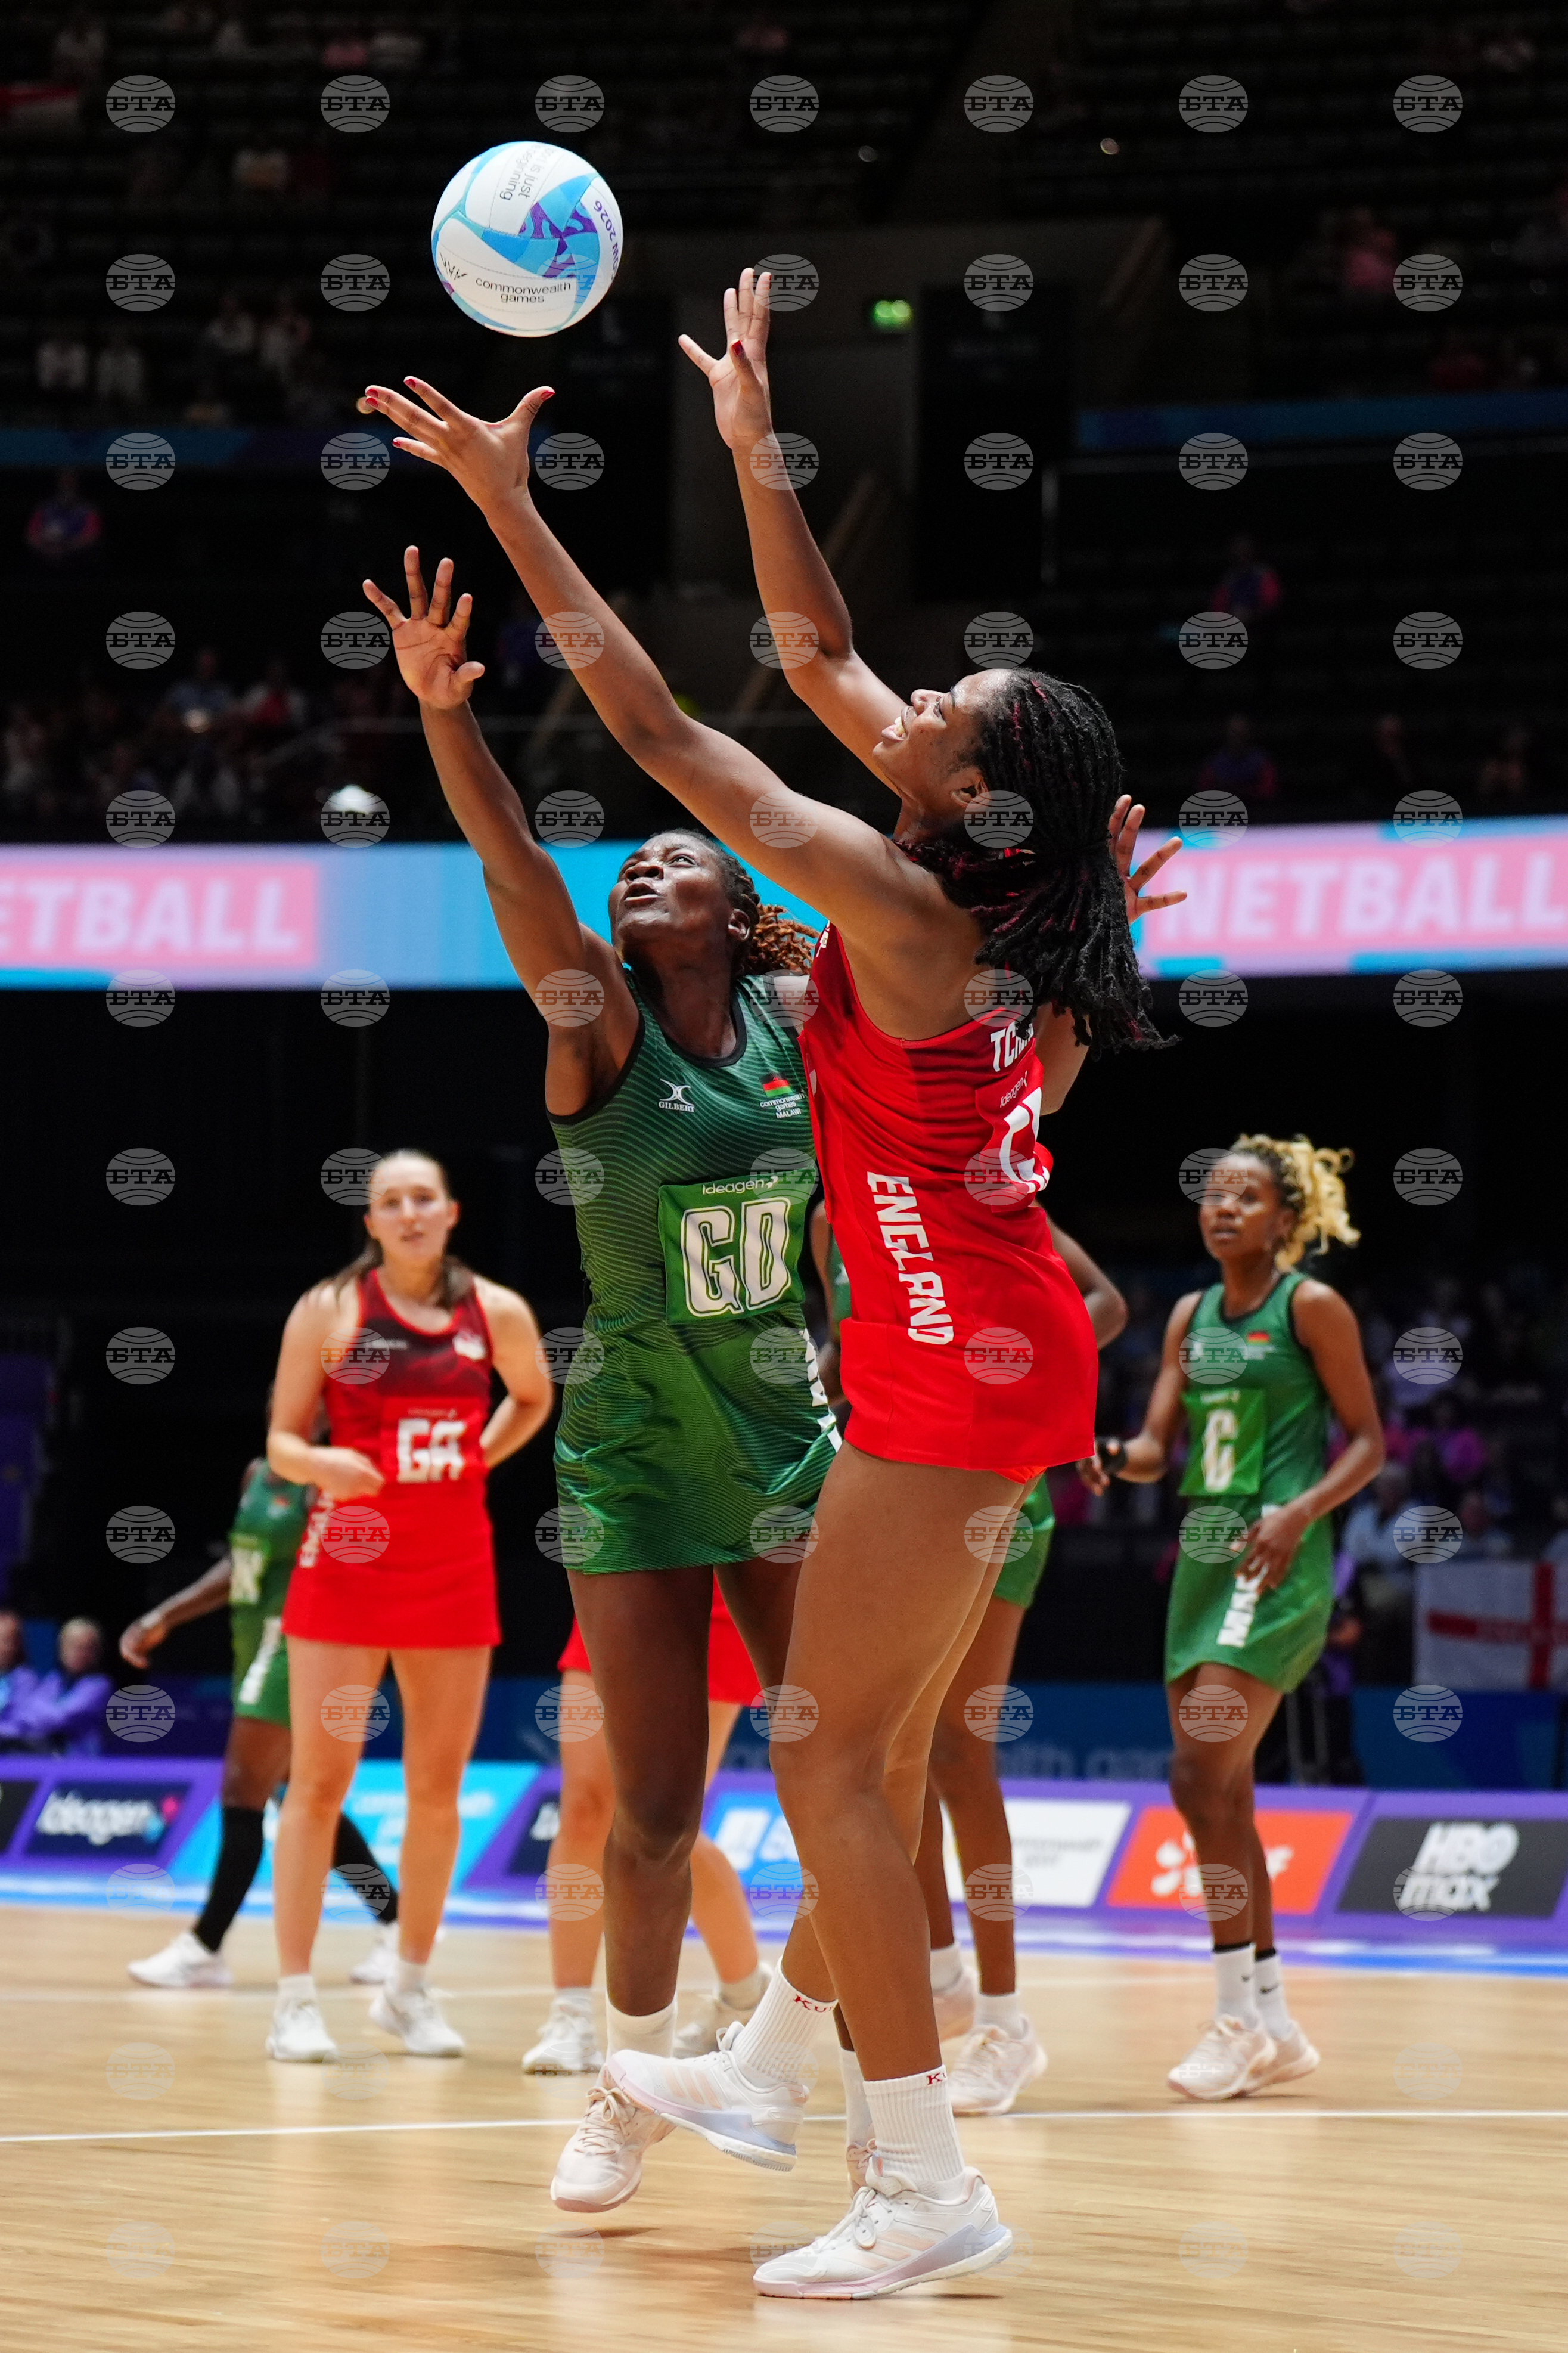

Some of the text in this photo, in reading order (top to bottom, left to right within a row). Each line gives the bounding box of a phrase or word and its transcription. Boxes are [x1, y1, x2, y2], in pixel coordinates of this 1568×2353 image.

[518, 173, 538, 199] just
[594, 200, 616, 241] 2026
[476, 278, 571, 294] commonwealth
[501, 293, 545, 303] games
[0, 879, 298, 950] TBALL
[1157, 852, 1566, 940] NETBALL
[658, 1101, 695, 1112] GILBERT
[775, 1101, 797, 1112] games
[775, 1108, 802, 1119] MALAWI
[702, 1179, 765, 1195] Ideagen
[680, 1196, 791, 1317] GD
[867, 1171, 954, 1345] ENGLAND
[397, 1418, 468, 1484] GA
[1410, 1822, 1520, 1874] HBO
[1398, 1874, 1500, 1912] max
